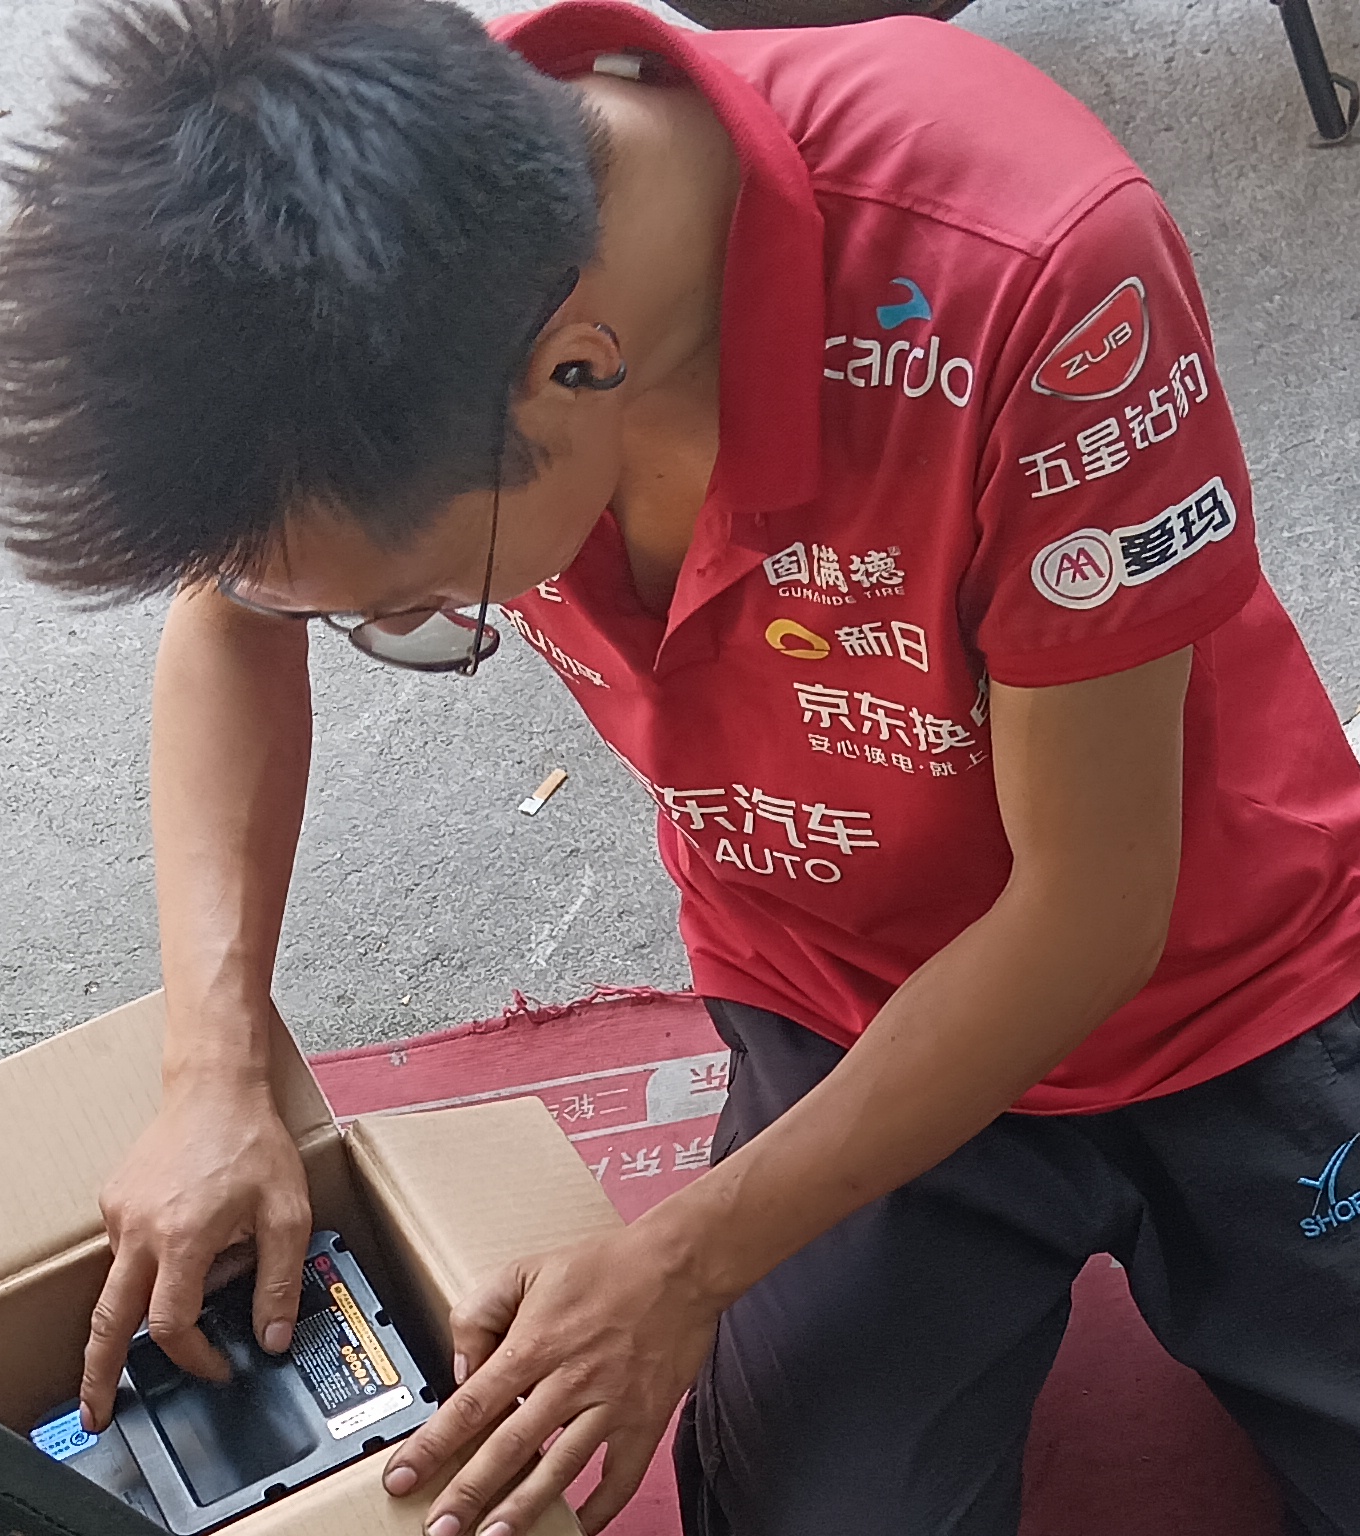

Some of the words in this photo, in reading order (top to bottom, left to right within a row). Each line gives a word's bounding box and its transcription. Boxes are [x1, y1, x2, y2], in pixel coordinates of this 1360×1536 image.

[1018, 352, 1208, 499] 五星钻豹
[1119, 486, 1232, 578] 爱玛
[863, 585, 905, 600] TIRE
[834, 620, 929, 673] 新日
[638, 762, 880, 855] 东汽车
[716, 838, 841, 884] AUTO
